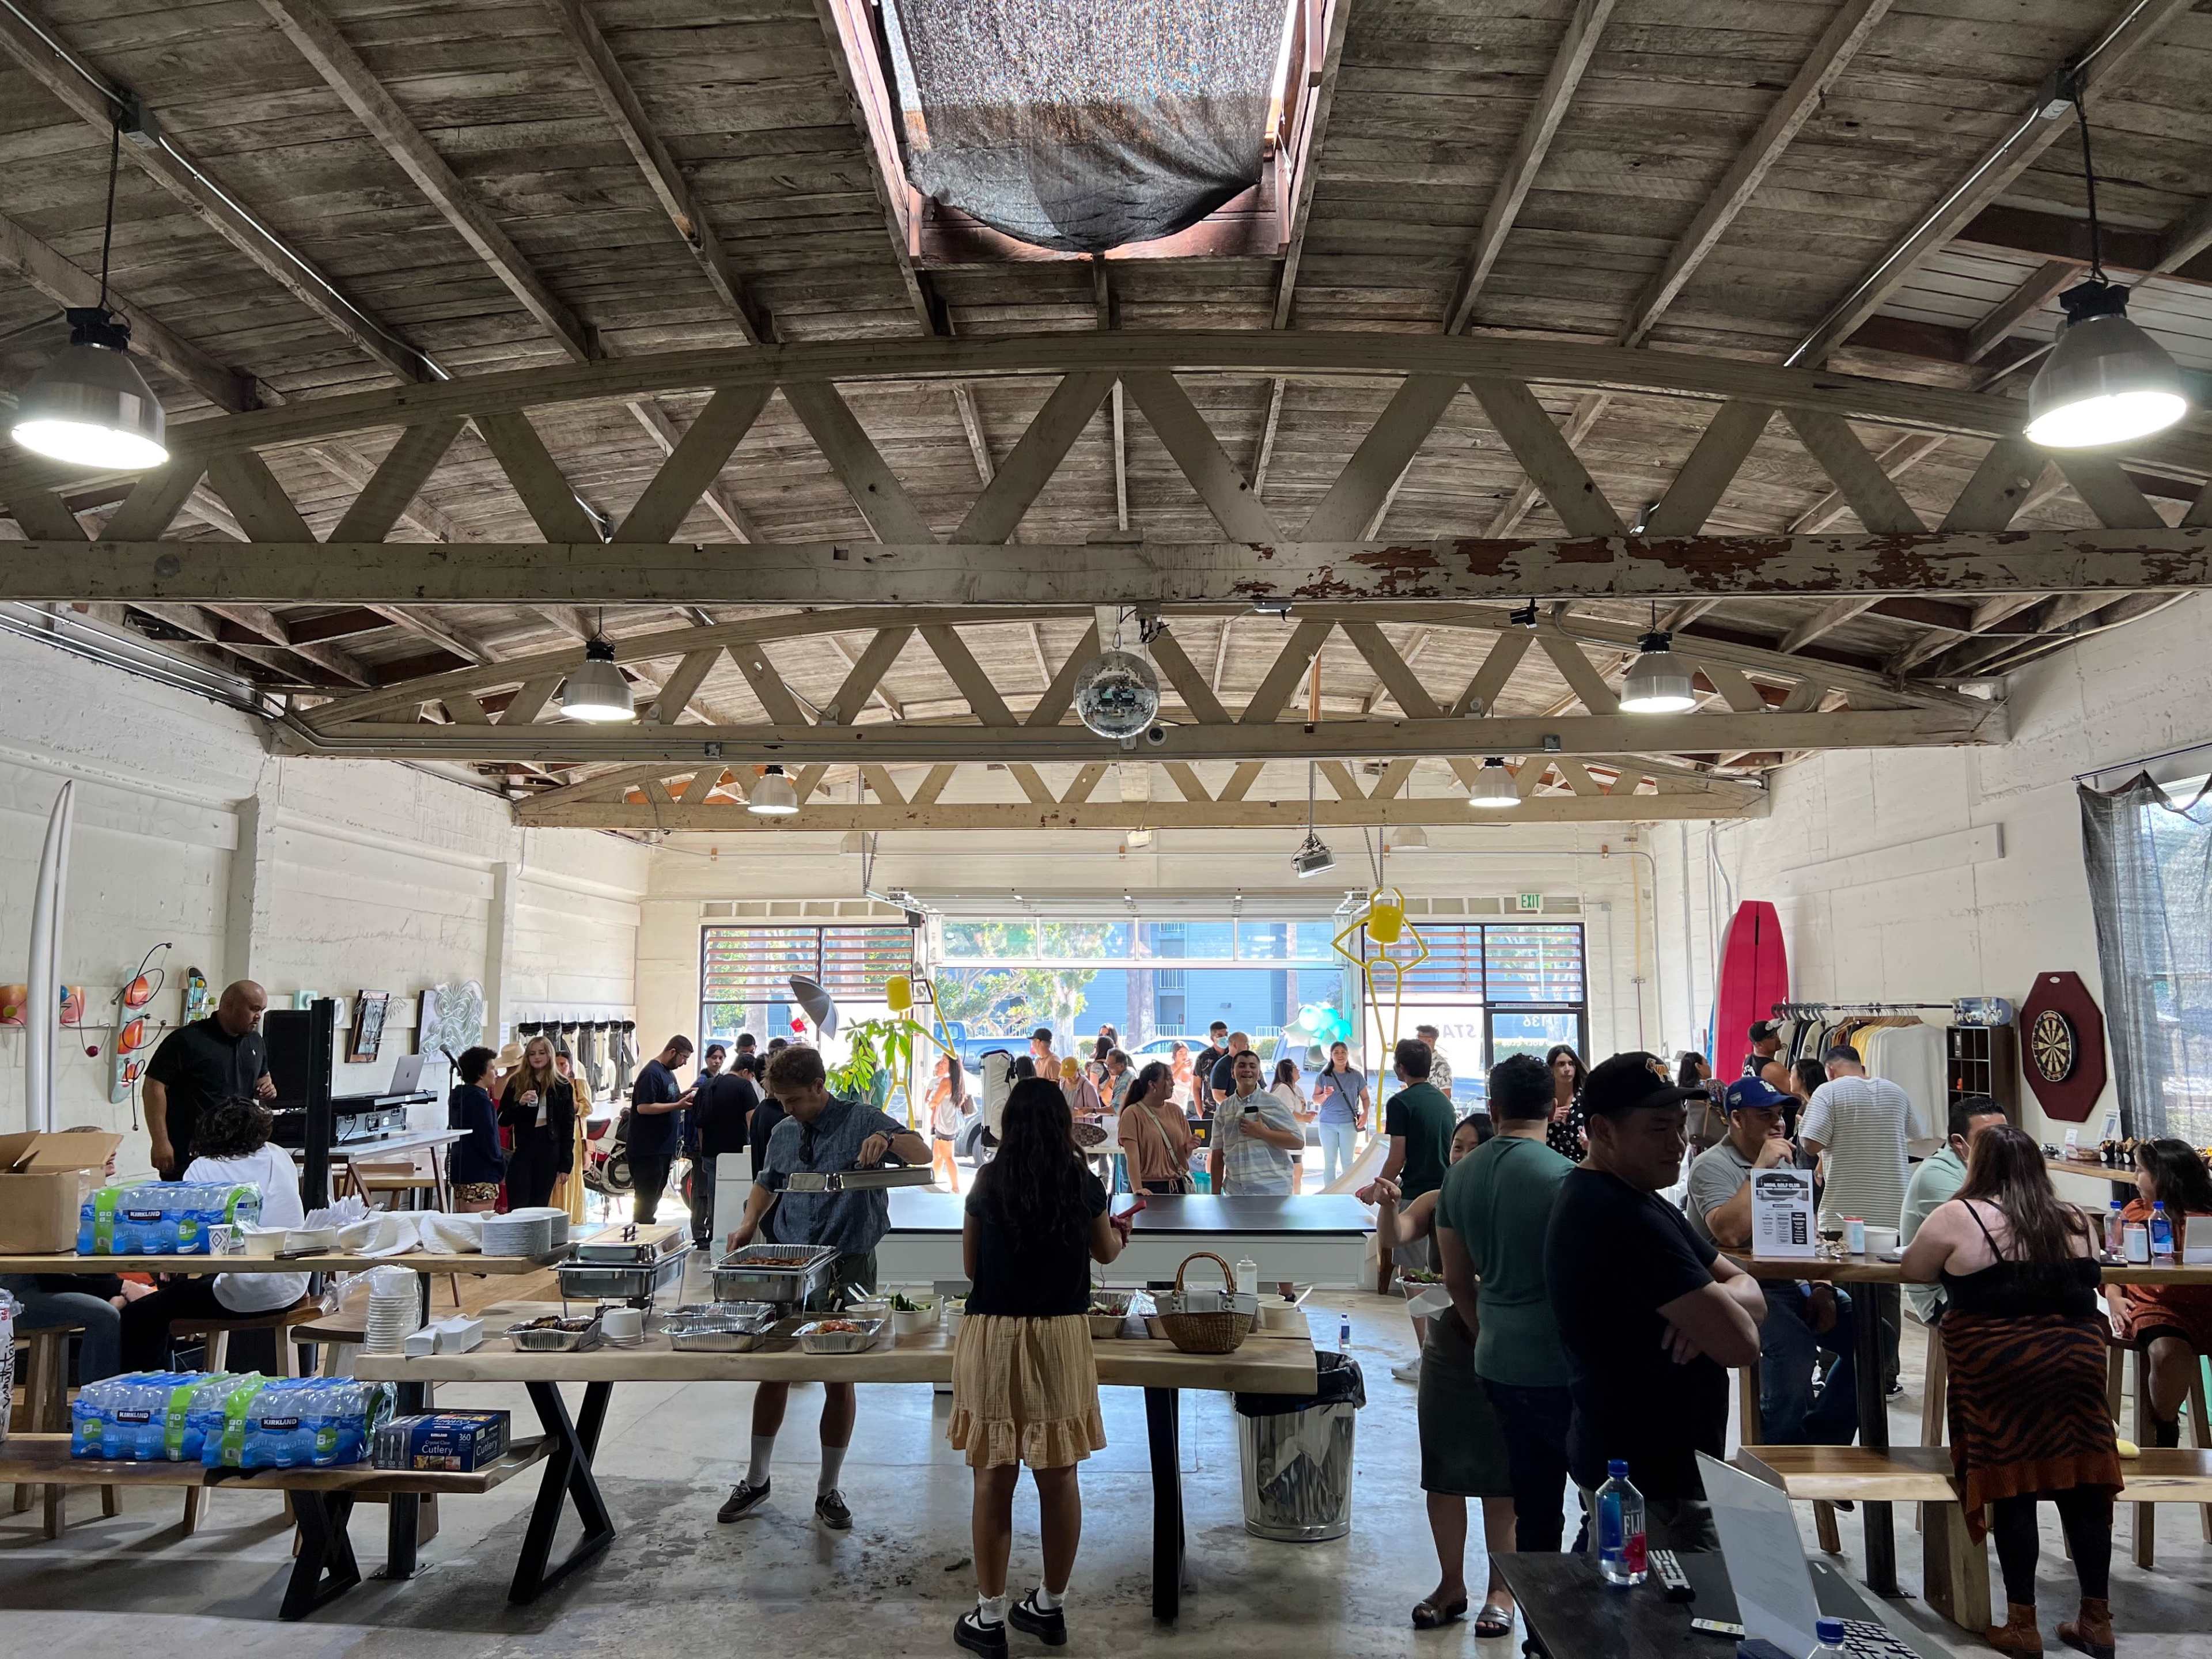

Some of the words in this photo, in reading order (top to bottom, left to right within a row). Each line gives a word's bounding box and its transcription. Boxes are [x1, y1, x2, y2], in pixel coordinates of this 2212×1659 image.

[1521, 894, 1540, 908] EXIT
[283, 1440, 309, 1450] water
[317, 1434, 326, 1445] 8
[422, 1445, 453, 1456] Cutlery
[476, 1439, 498, 1456] Cutlery
[1623, 1513, 1645, 1535] FIJI
